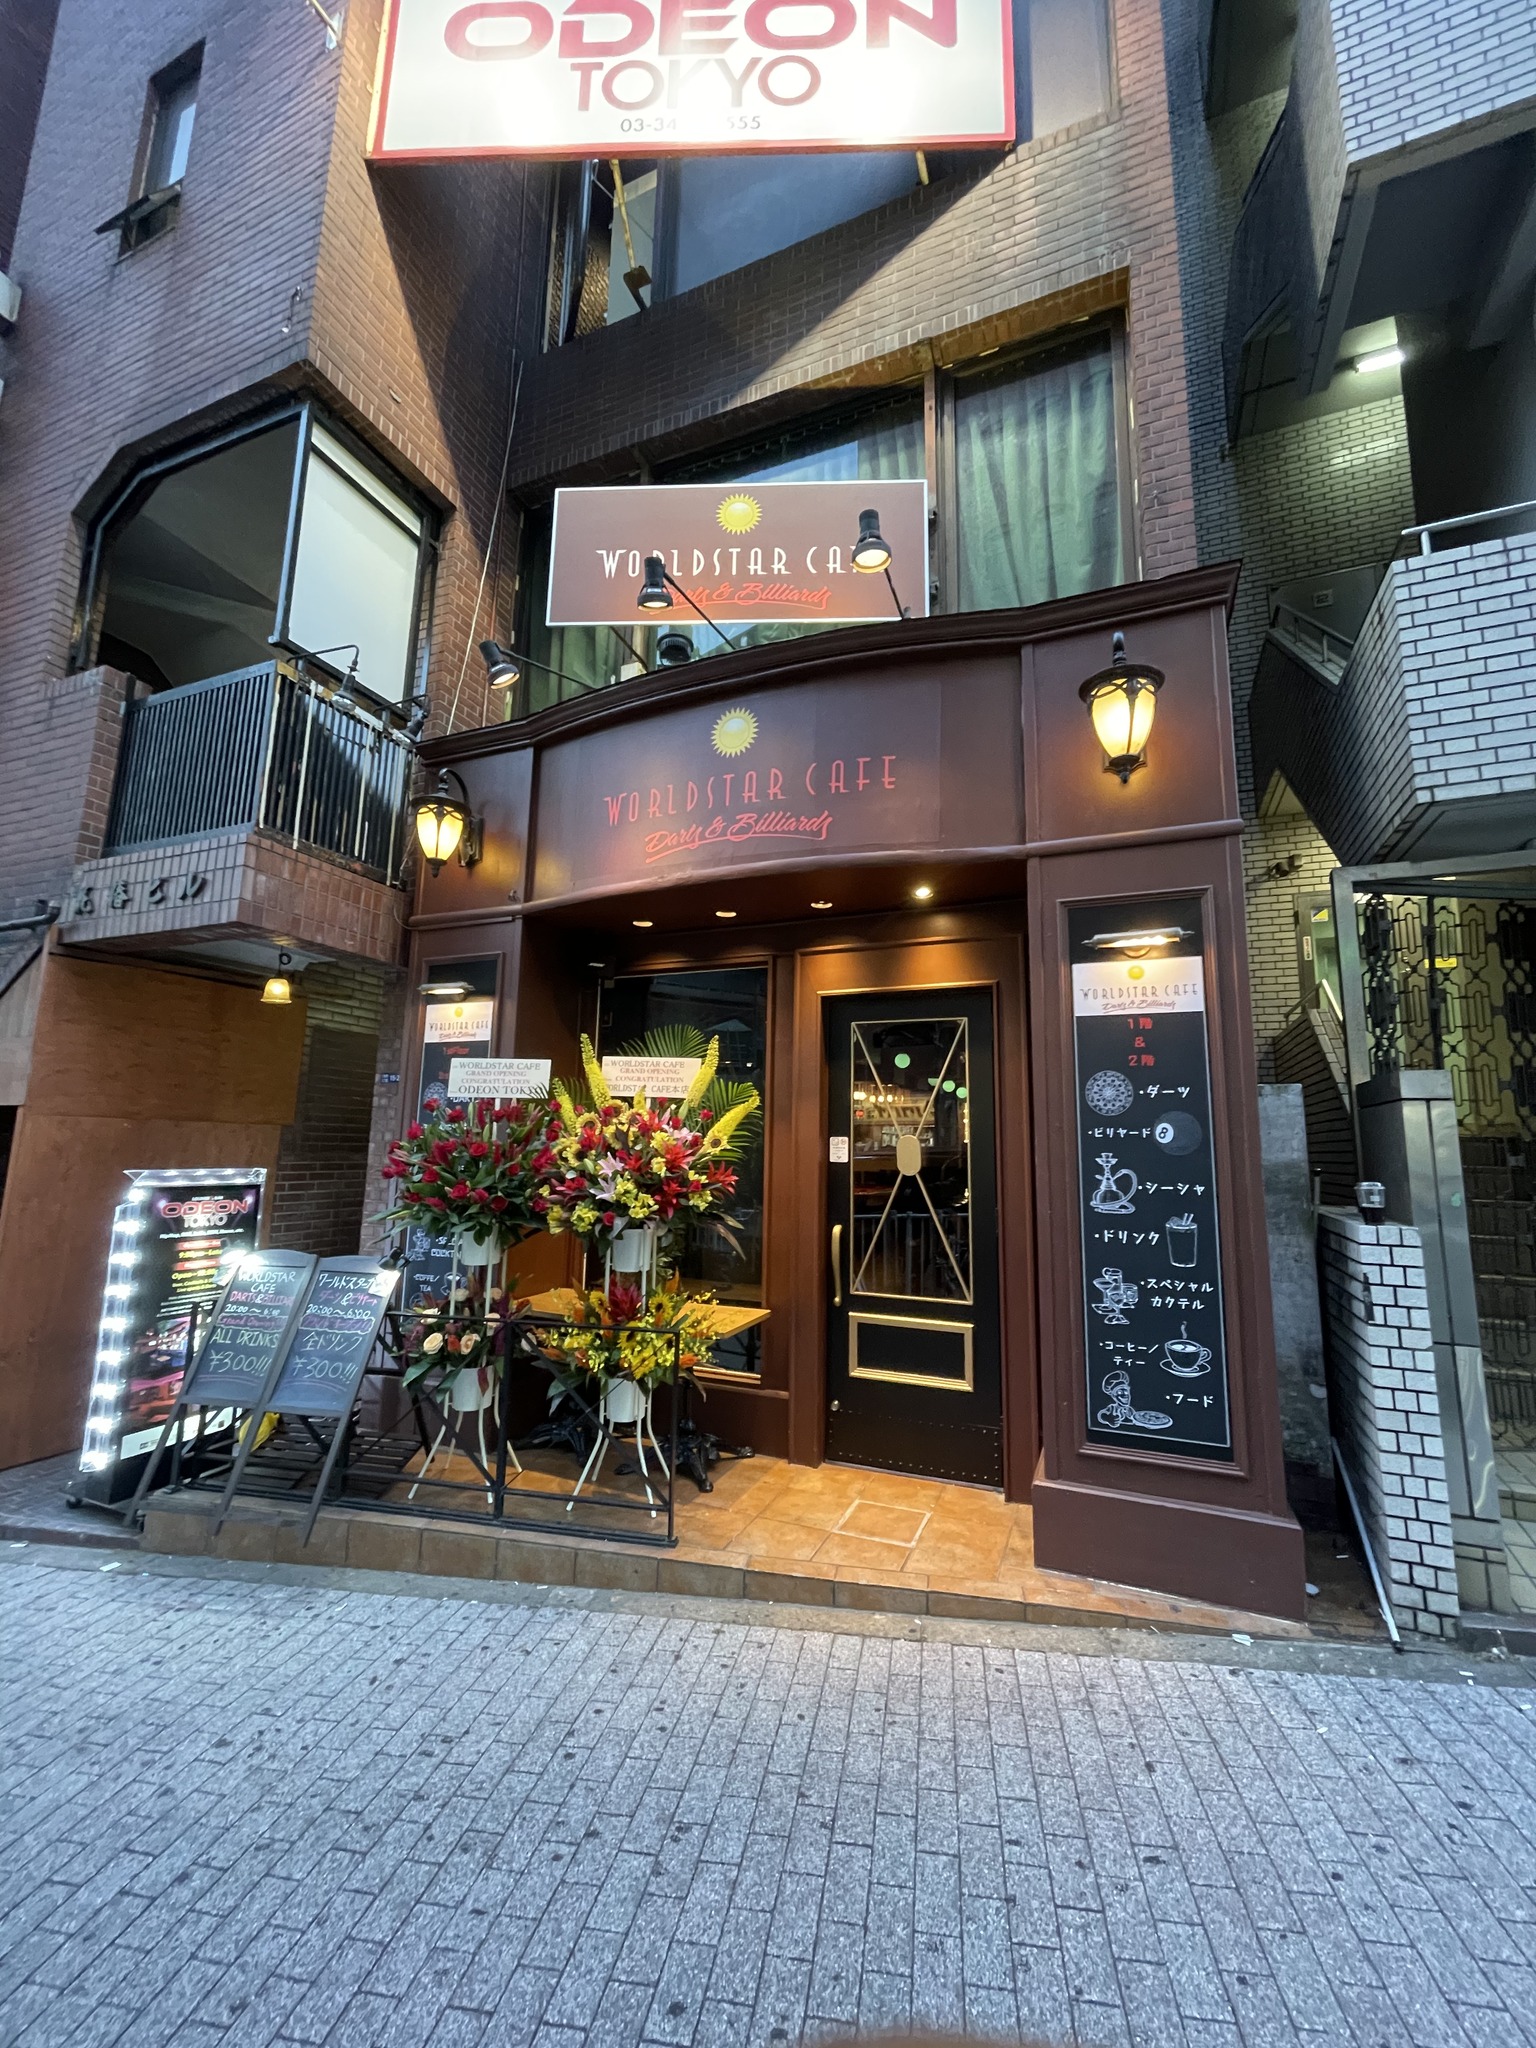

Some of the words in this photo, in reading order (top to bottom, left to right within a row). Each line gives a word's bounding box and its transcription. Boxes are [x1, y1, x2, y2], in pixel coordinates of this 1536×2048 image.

[444, 0, 958, 61] ODEON
[806, 546, 886, 574] CA
[712, 581, 735, 600] &
[735, 581, 832, 609] Billiards
[603, 767, 787, 827] WORLDSTAR
[806, 755, 897, 795] CAFE
[645, 823, 703, 854] Darts
[705, 816, 727, 838] &
[727, 810, 833, 842] Billiards
[1080, 986, 1159, 1000] WORLDSTAR
[1165, 983, 1199, 997] CAFE
[1101, 1002, 1127, 1011] Darts
[1136, 999, 1177, 1010] Billiards
[1134, 1036, 1146, 1048] &
[459, 1061, 514, 1070] WORLDSTAR
[517, 1062, 541, 1070] CAFE
[611, 1060, 660, 1068] WORLDSTAR
[663, 1061, 685, 1069] CAFE
[458, 1085, 499, 1095] ODEON
[161, 1200, 249, 1218] ODEON
[183, 1214, 228, 1228] TOKYO
[239, 1271, 297, 1283] WORLDSTAR
[250, 1282, 277, 1294] CAFE
[1150, 1296, 1205, 1310] カクテル
[209, 1328, 232, 1345] ALL
[236, 1330, 280, 1348] DRINKS
[1113, 1356, 1146, 1367] ティー
